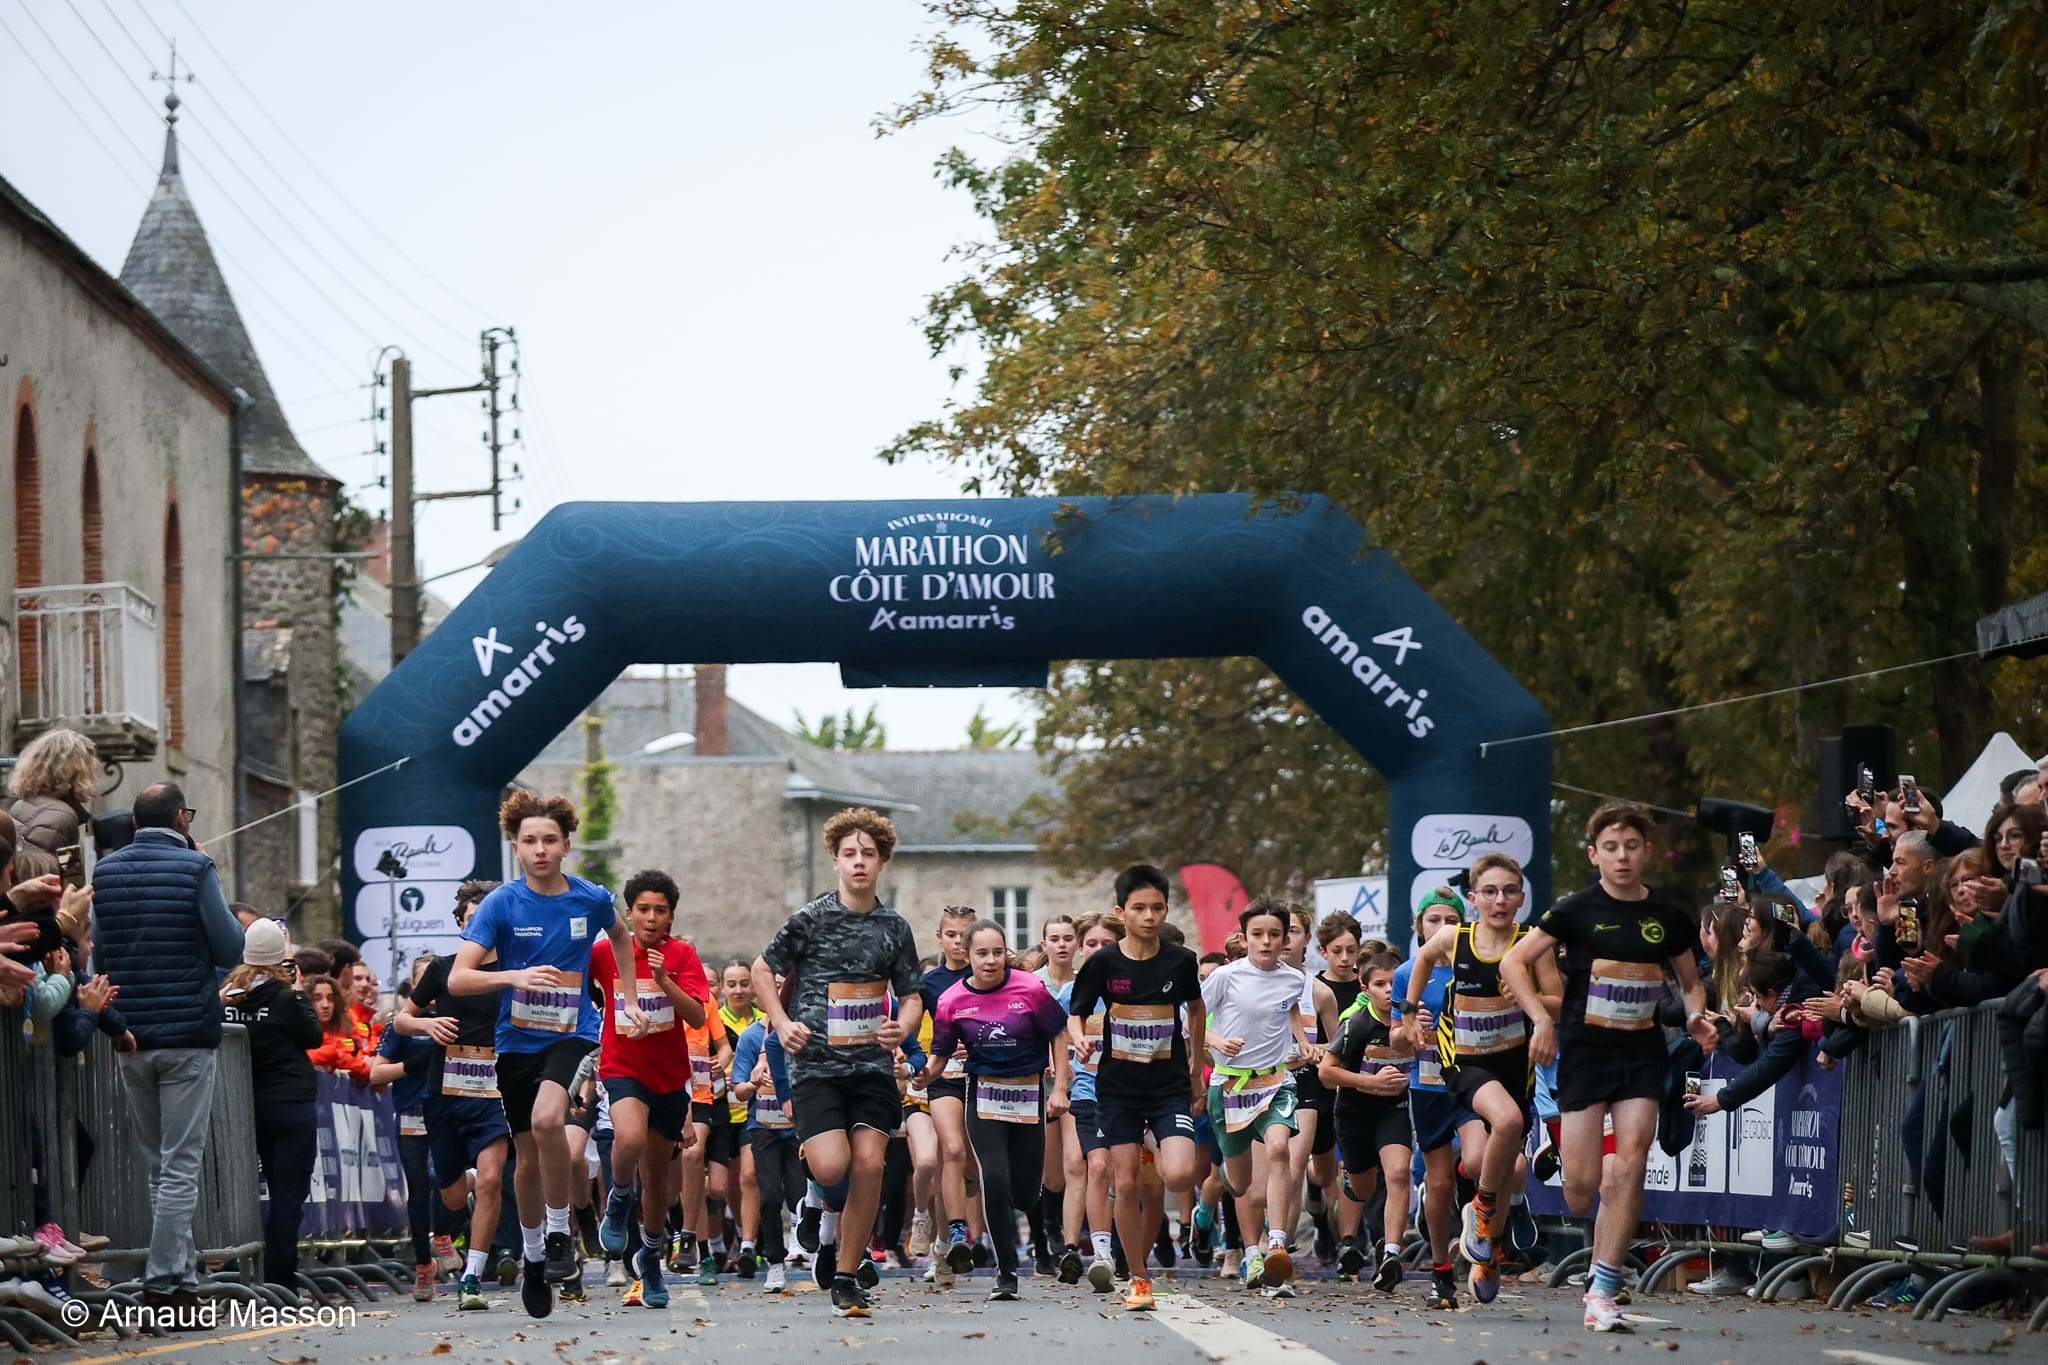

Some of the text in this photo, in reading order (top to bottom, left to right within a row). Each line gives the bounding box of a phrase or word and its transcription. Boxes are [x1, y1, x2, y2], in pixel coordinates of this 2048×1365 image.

[887, 512, 992, 530] INTERNATIONAL
[856, 535, 1028, 566] MARATHON
[829, 568, 1056, 602] CÔTE D'AMOUR
[899, 605, 1016, 630] amarris
[1302, 605, 1435, 738] amarris
[452, 615, 587, 747] amarris
[382, 917, 445, 932] Puliguen
[637, 996, 666, 1012] 067
[224, 1006, 270, 1022] STF
[1124, 1024, 1162, 1041] 16017
[989, 1086, 1028, 1103] 16005
